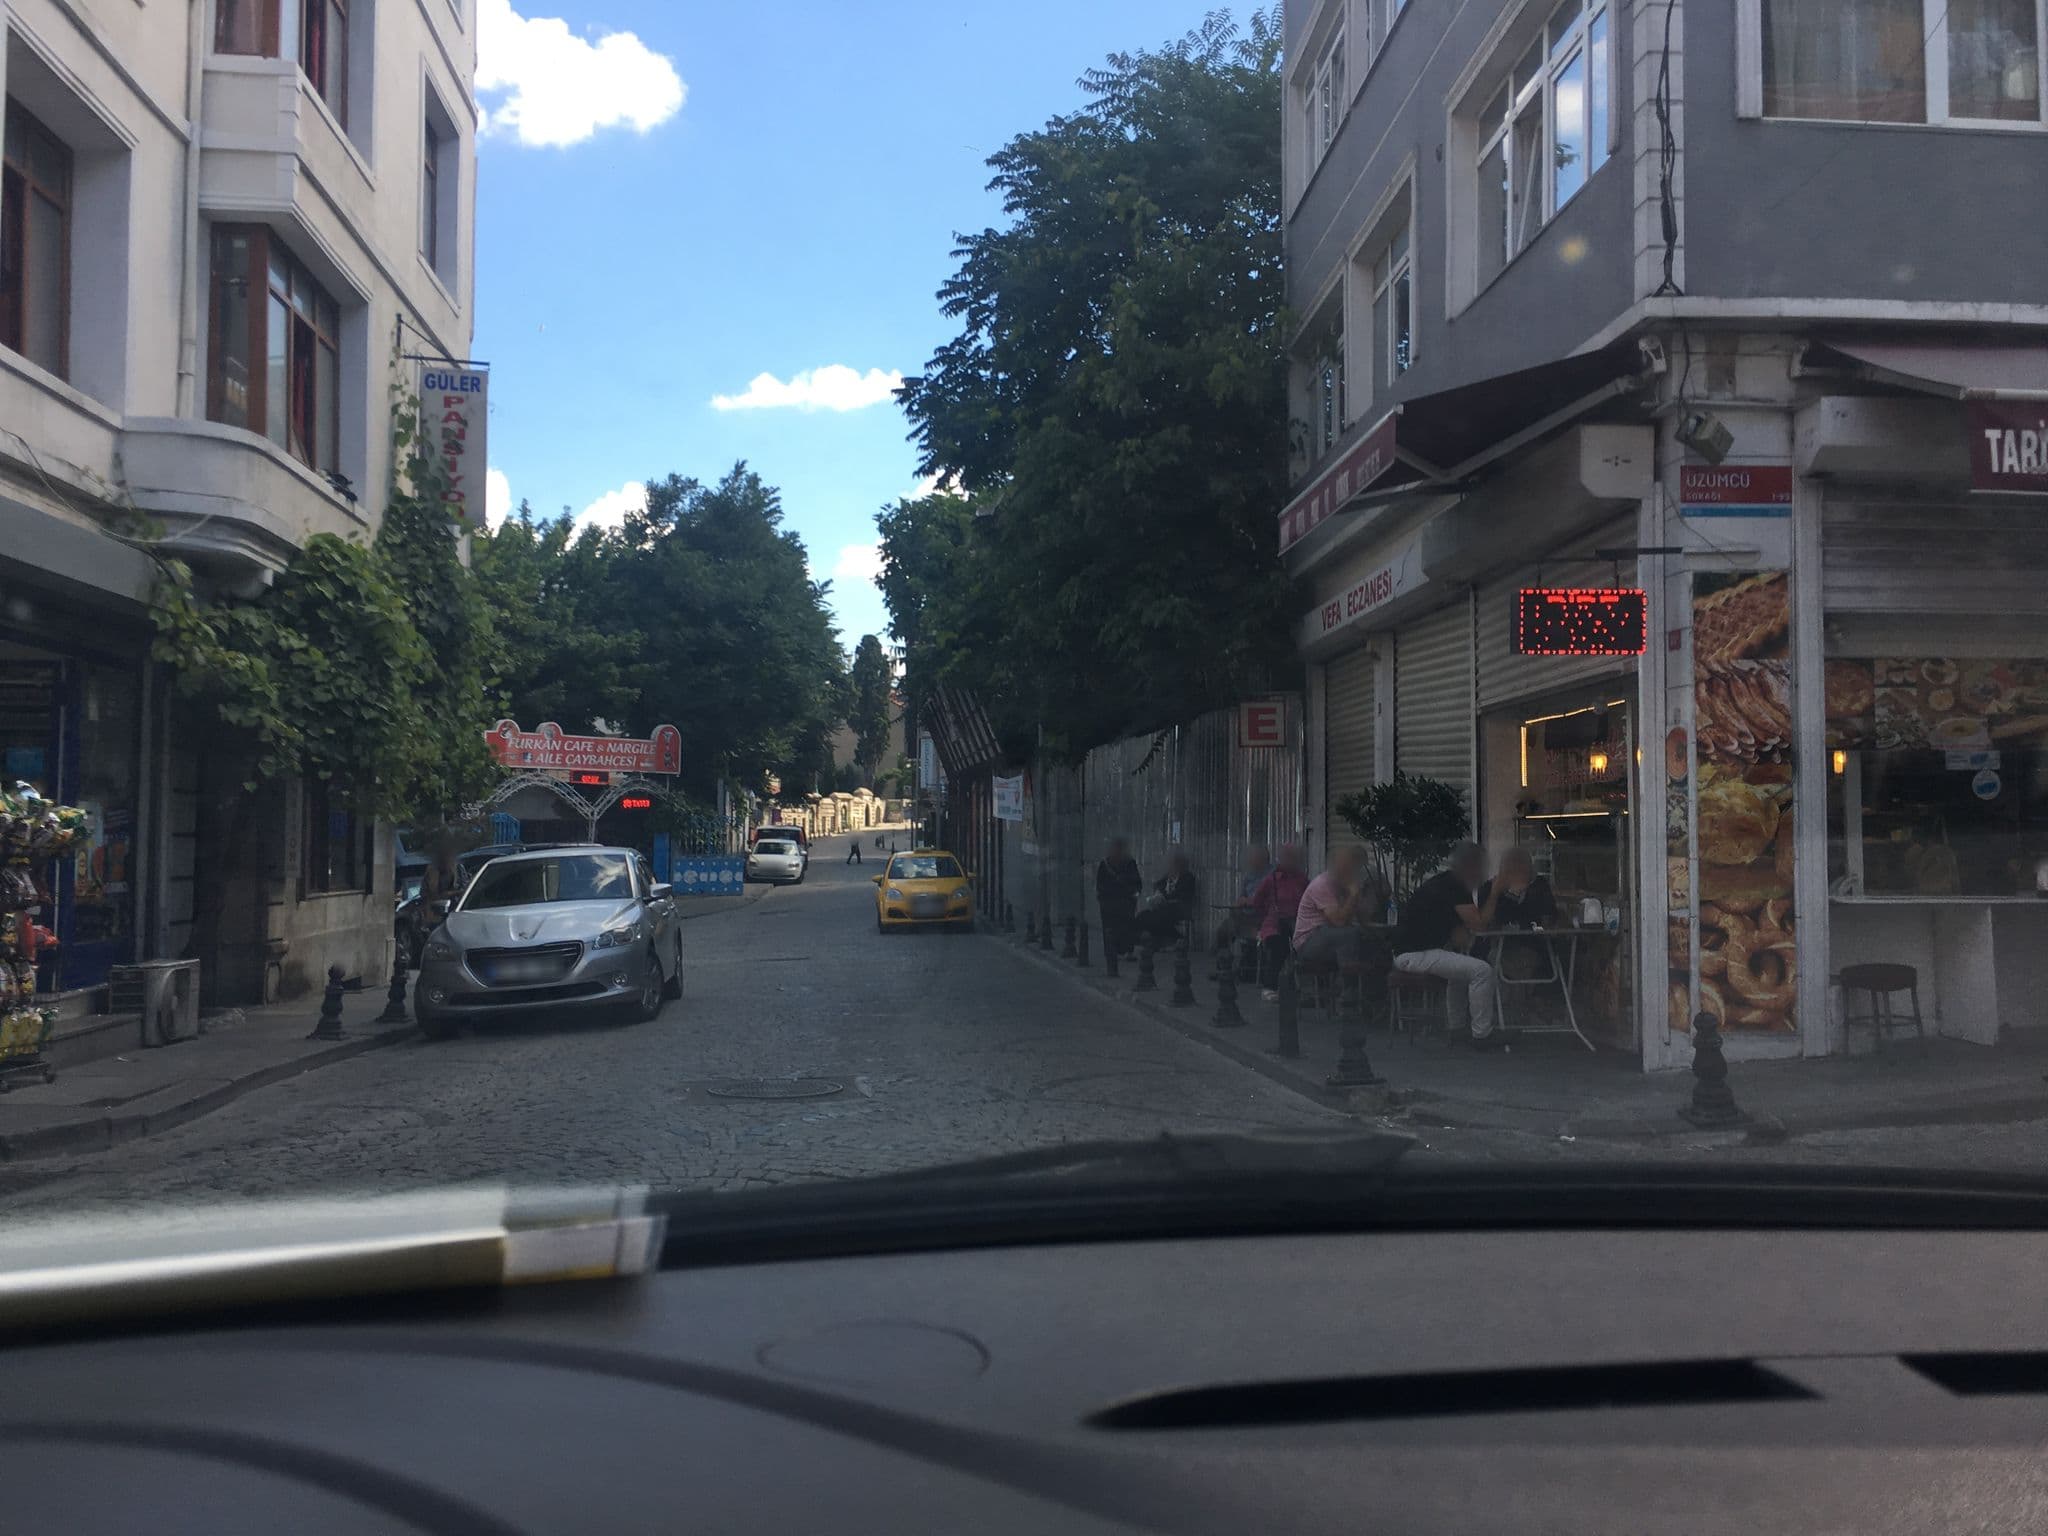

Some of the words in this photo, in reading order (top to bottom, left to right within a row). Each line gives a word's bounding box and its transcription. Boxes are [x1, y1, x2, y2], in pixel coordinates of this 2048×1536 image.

[424, 369, 481, 393] GÜLER
[1321, 600, 1342, 632] VEFA
[1247, 707, 1278, 740] E
[508, 738, 561, 751] FURKAN
[564, 740, 593, 752] CAFE
